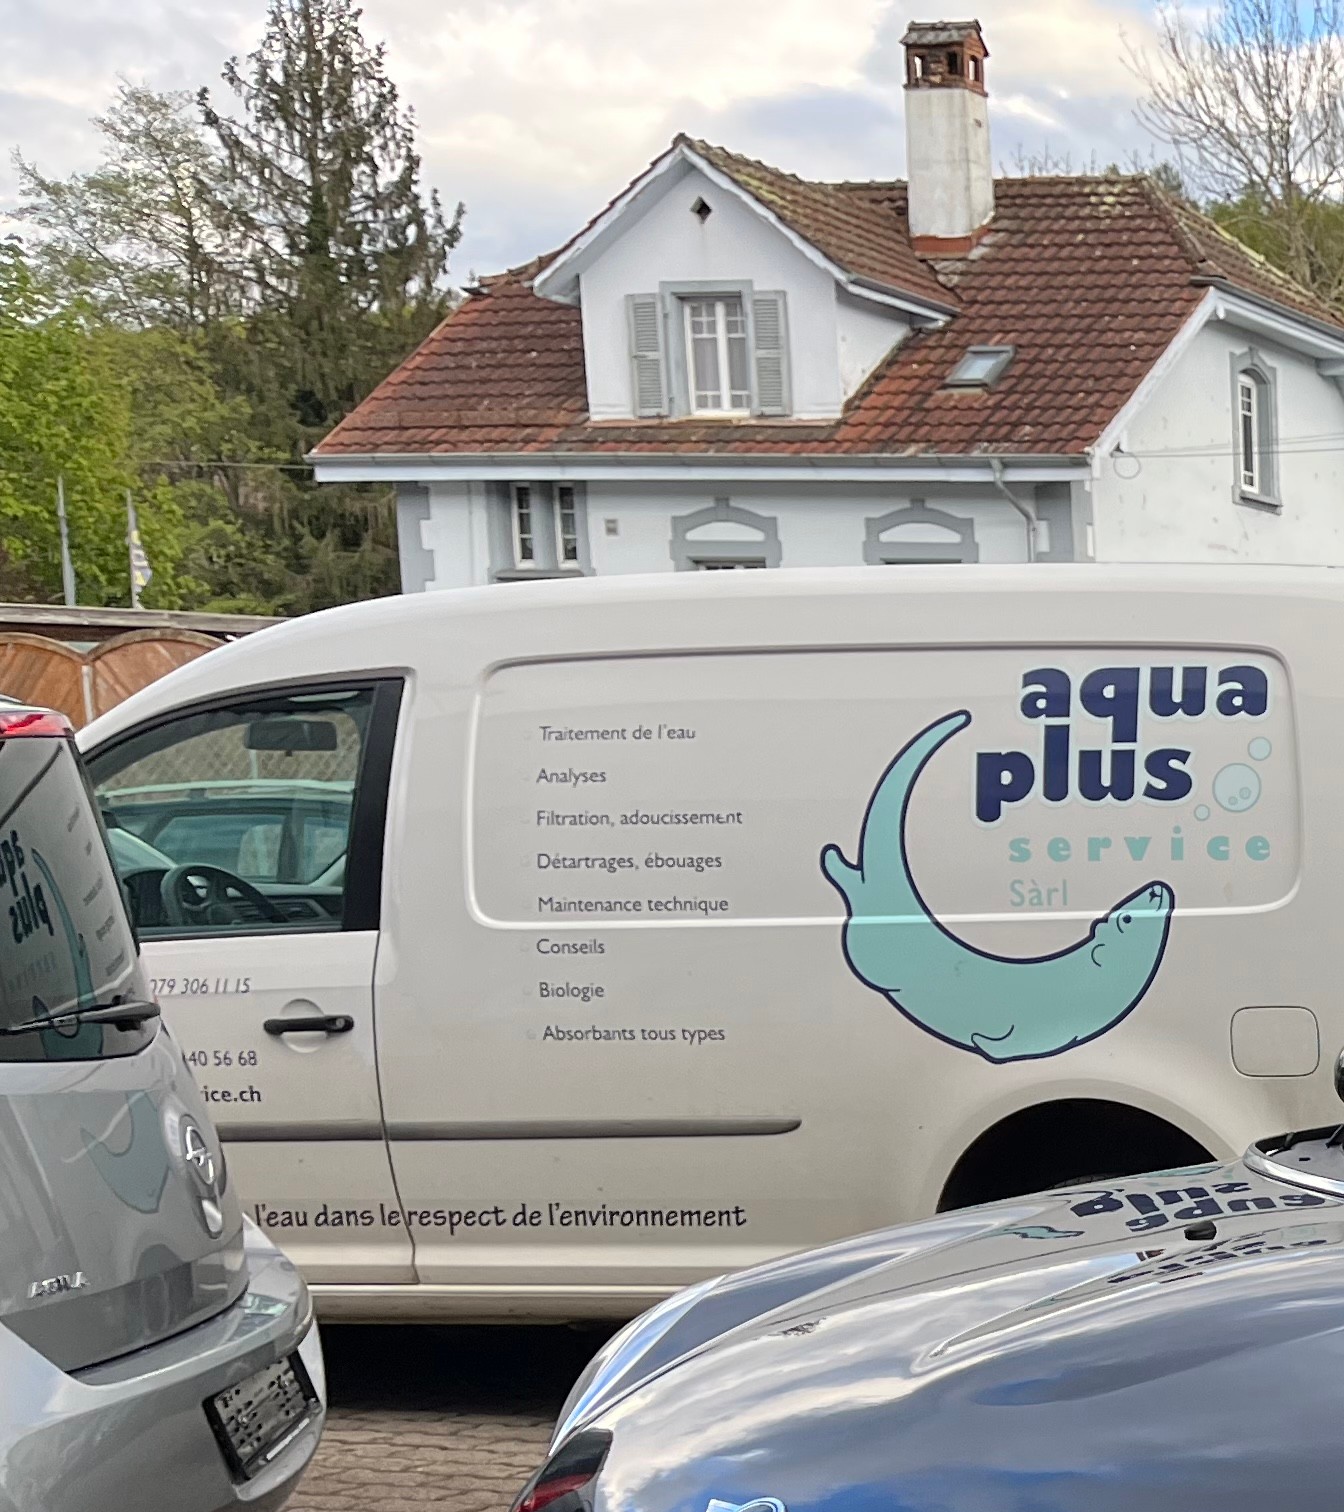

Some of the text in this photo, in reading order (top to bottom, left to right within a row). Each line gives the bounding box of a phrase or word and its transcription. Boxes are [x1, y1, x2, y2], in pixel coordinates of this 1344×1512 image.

[1019, 664, 1270, 743] aqua
[539, 723, 696, 742] Traitement de l'eau
[536, 767, 607, 787] Analyses
[974, 723, 1193, 822] plus
[536, 809, 743, 828] Filtration, adoucissement
[1009, 825, 1271, 863] service
[536, 851, 723, 873] Détartrages, ébouages
[1010, 878, 1069, 908] Sàrl
[537, 894, 729, 918] Maintenance technique
[536, 938, 606, 956] Conseils
[180, 978, 209, 994] 306
[214, 978, 229, 994] 11
[235, 978, 251, 994] 15
[538, 981, 605, 1002] Biologie
[542, 1024, 726, 1045] Absorbants tous types
[213, 1050, 233, 1067] 56
[238, 1050, 258, 1067] 68
[254, 1202, 747, 1236] l'eau dans le respect de l'environnement
